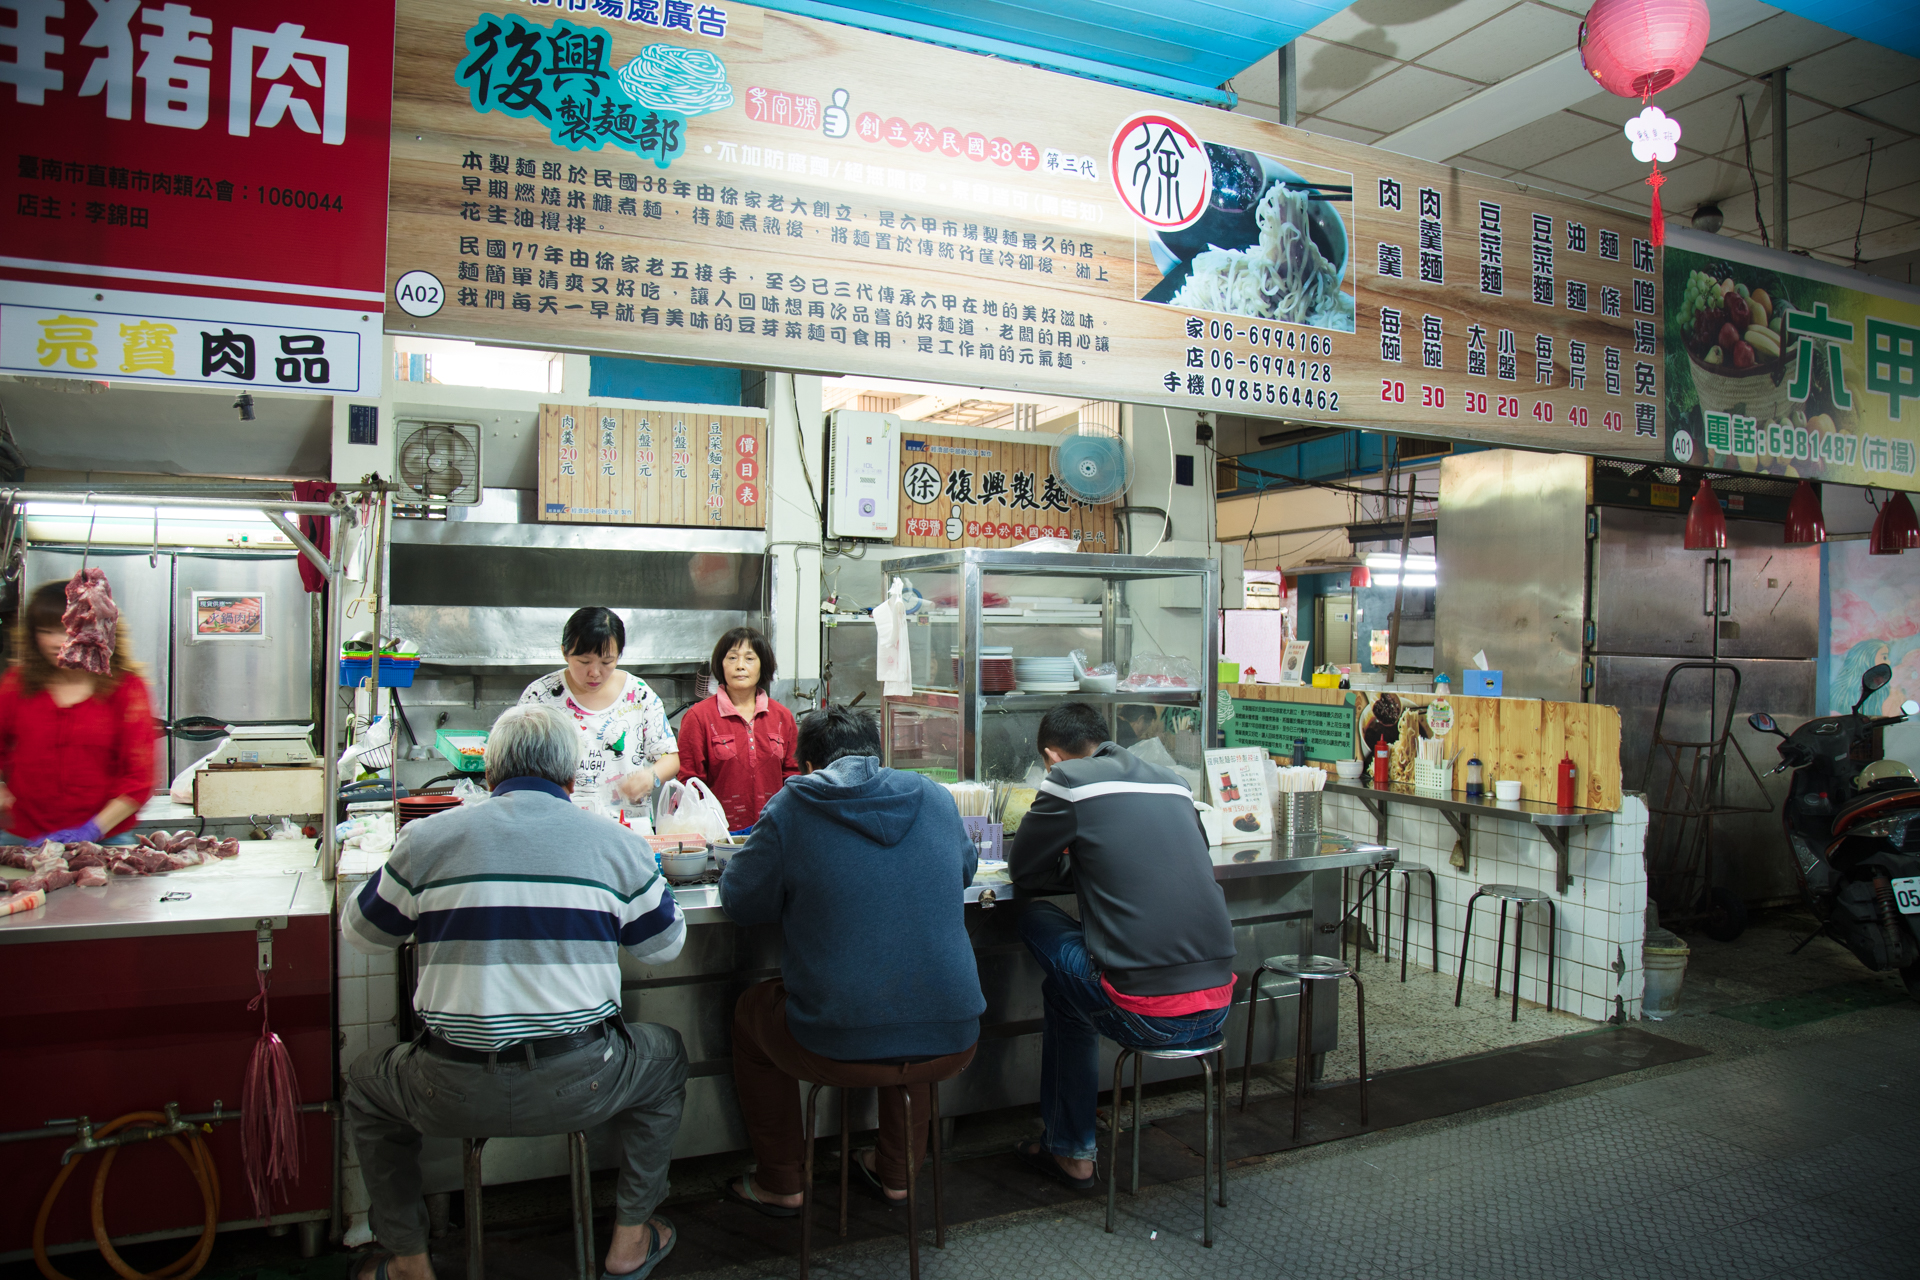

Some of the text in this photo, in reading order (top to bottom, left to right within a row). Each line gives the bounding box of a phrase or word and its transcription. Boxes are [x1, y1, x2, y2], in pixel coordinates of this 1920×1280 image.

[463, 21, 611, 121] 復興
[555, 95, 681, 162] 製麵部
[857, 112, 1096, 180] 創立於民國38年 第三代
[400, 283, 439, 304] A02
[1420, 187, 1444, 408] 肉羹麵 每碗 30
[1466, 201, 1502, 413] 豆菜麵 大盤 30
[1186, 318, 1332, 356] 家 06-6994166
[1381, 308, 1400, 362] 每碗
[1532, 213, 1553, 422] 豆菜麵 每斤 40
[1186, 347, 1332, 383] 店 06-6994128
[1498, 330, 1519, 418] 小盤 20
[1569, 341, 1586, 389] 每斤
[1604, 347, 1620, 395] 每包
[1787, 302, 1920, 421] 六甲
[1163, 371, 1340, 412] 手機 0985564462
[1382, 380, 1405, 403] 20
[1569, 408, 1588, 427] 40
[1604, 412, 1622, 431] 40
[1674, 438, 1692, 455] A01
[738, 436, 756, 504] 價目表
[907, 466, 940, 500] 徐
[946, 470, 1093, 513] 復興製麵
[1073, 529, 1106, 543] 第三代
[576, 760, 606, 772] AUGH!
